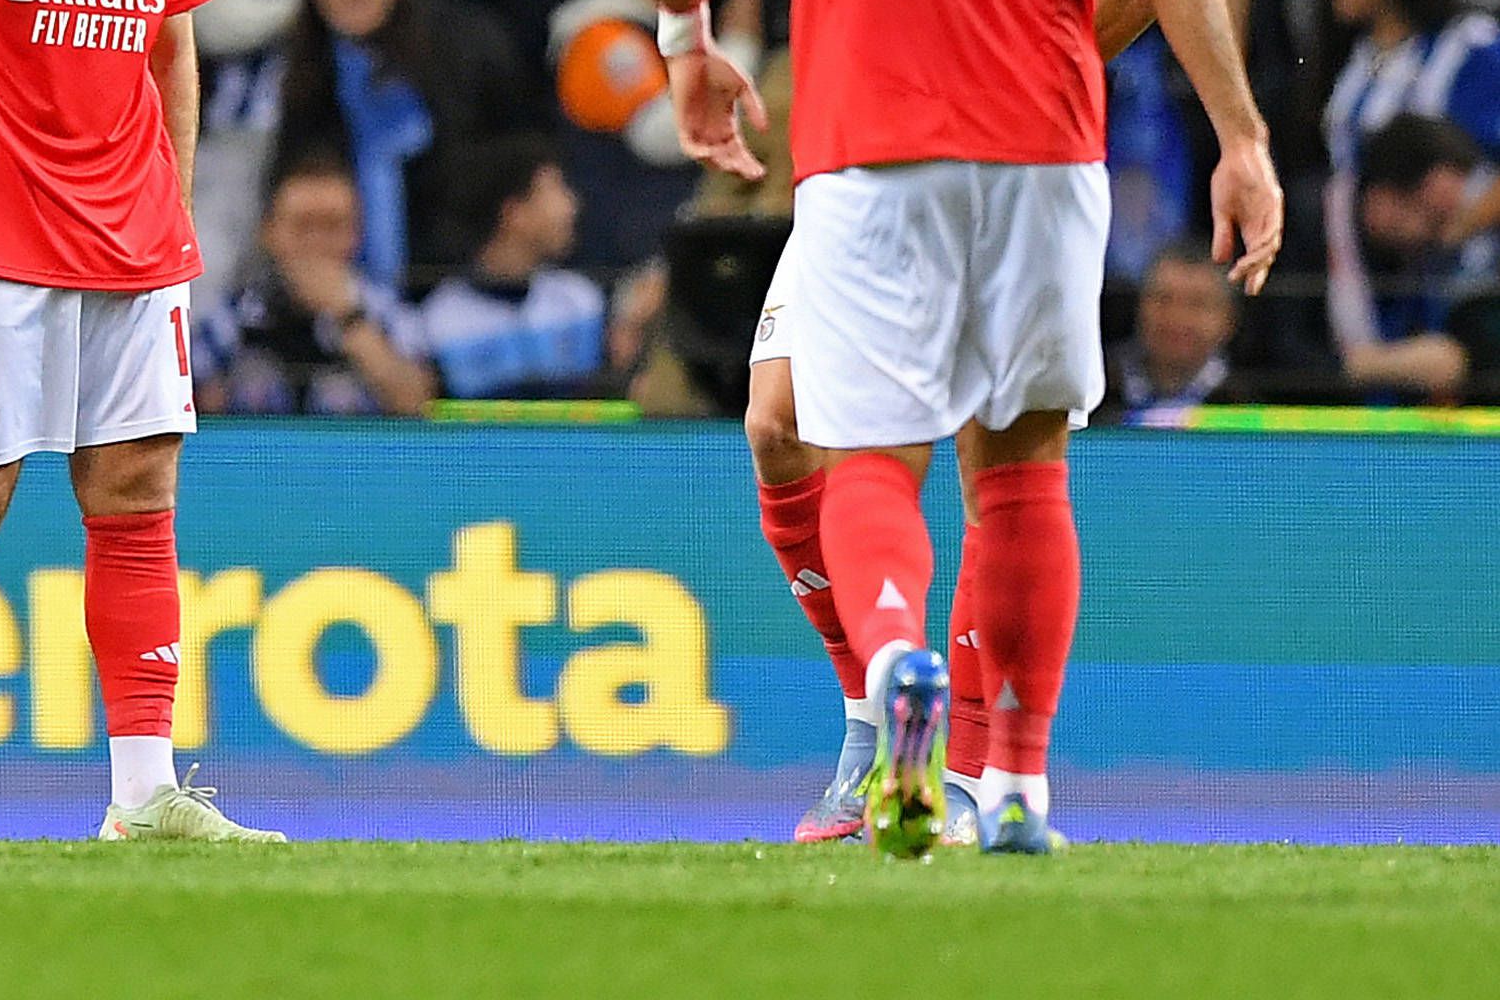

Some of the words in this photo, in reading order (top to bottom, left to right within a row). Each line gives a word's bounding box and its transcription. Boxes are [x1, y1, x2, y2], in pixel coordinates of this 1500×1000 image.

[31, 9, 70, 46] FLY
[72, 12, 147, 53] BETTER
[170, 306, 191, 377] 1
